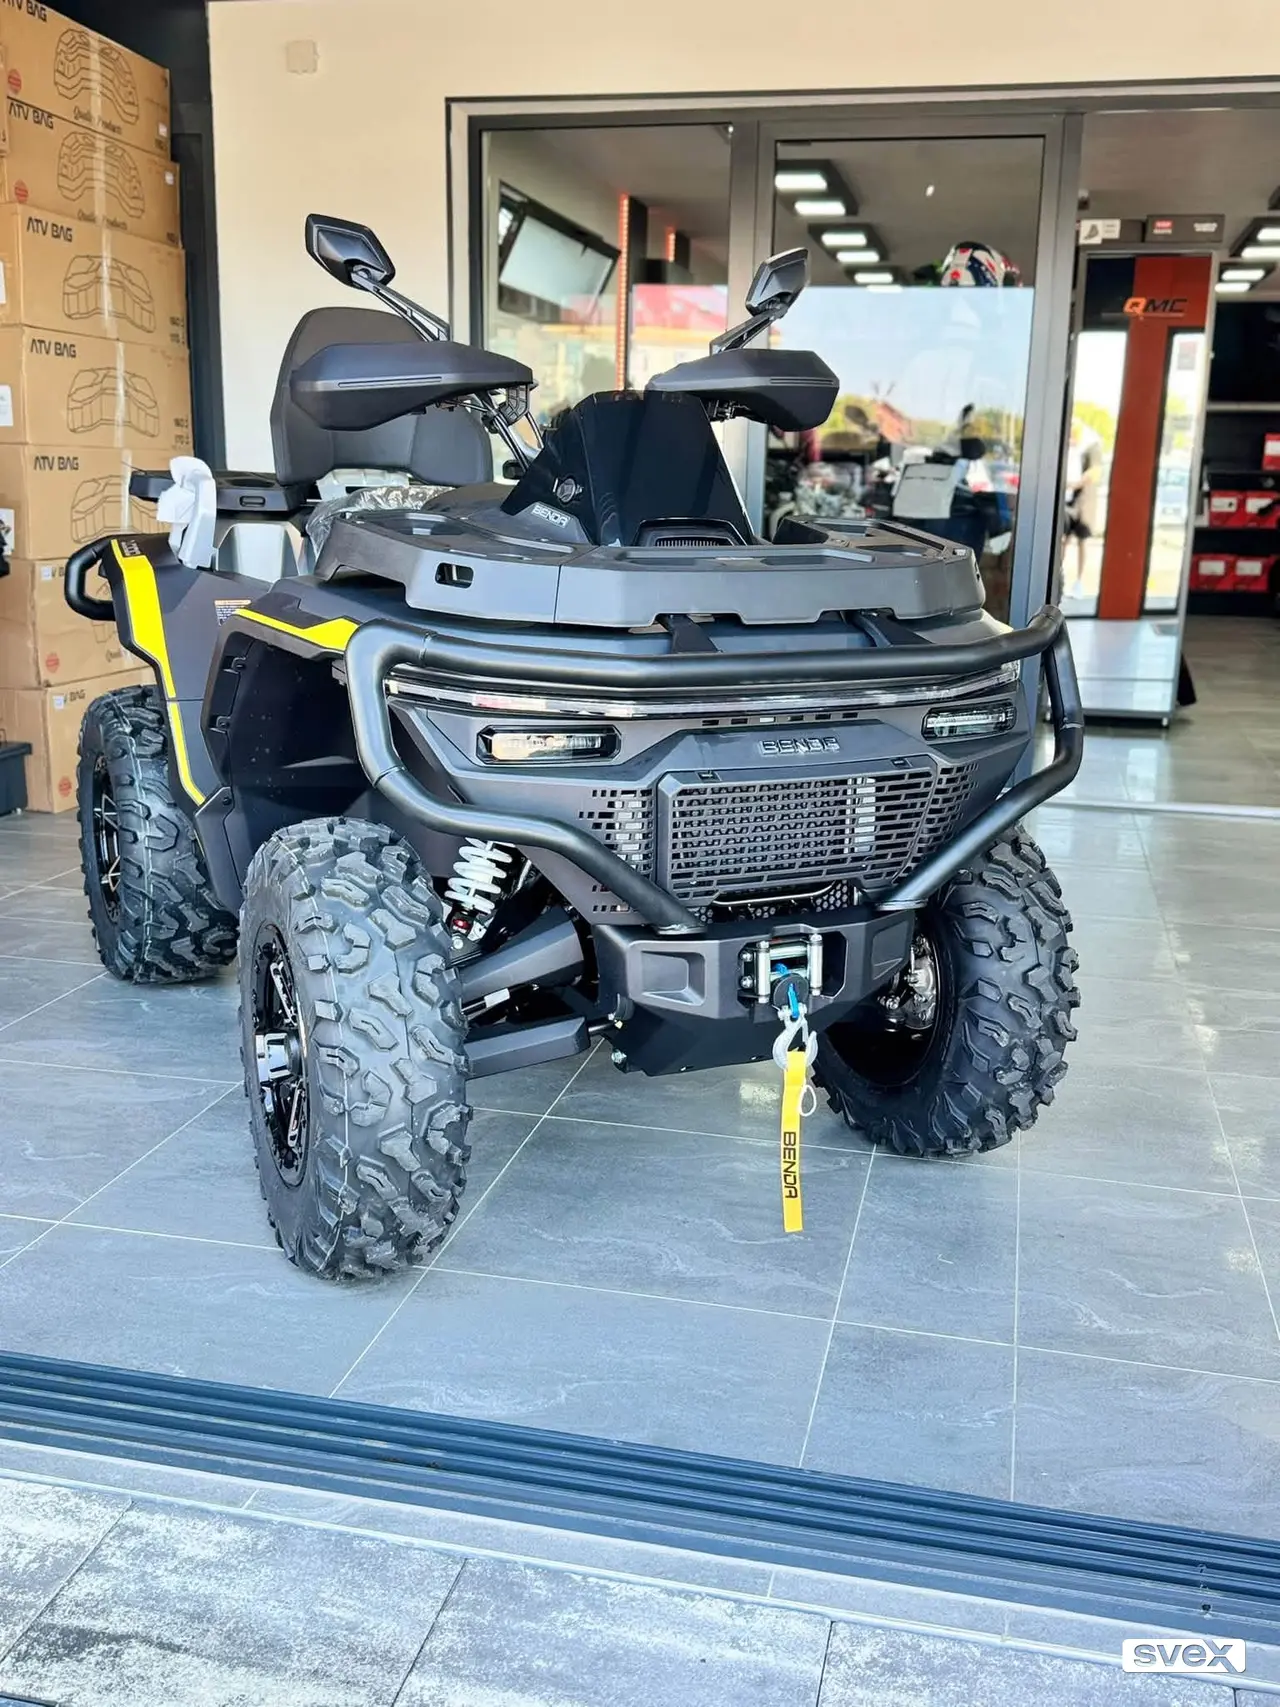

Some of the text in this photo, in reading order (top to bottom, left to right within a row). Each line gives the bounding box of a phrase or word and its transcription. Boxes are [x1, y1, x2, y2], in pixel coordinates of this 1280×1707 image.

[8, 102, 54, 129] ATV BAG
[26, 216, 73, 242] ATV BAG
[1123, 297, 1187, 317] QMC
[30, 338, 76, 358] ATV BAG
[34, 456, 79, 471] ATV BAG
[531, 503, 571, 528] BENDA
[782, 1131, 799, 1199] BENDA
